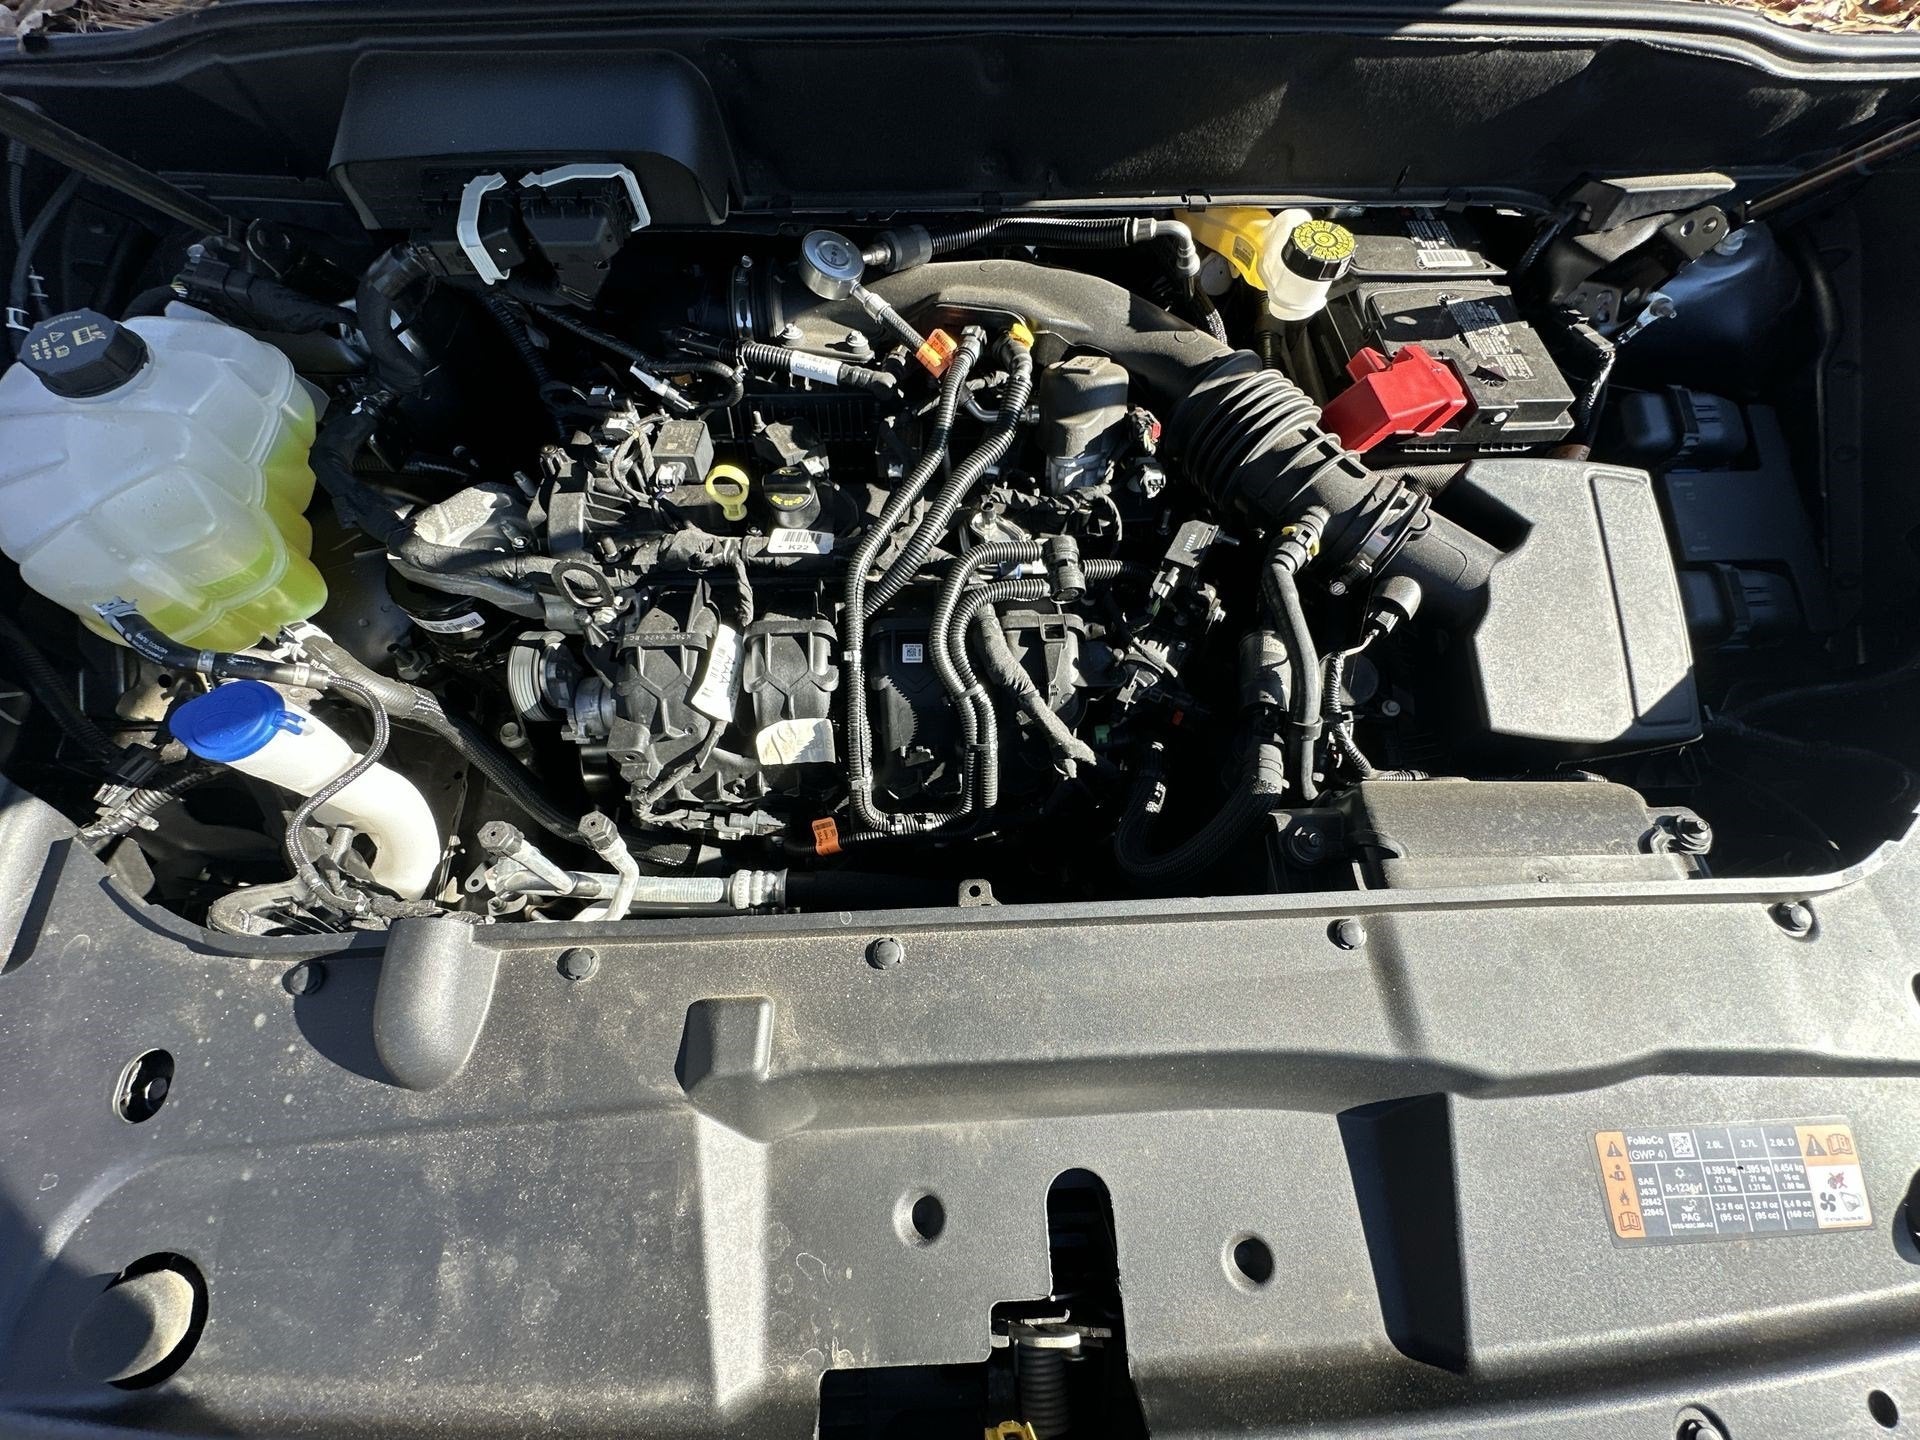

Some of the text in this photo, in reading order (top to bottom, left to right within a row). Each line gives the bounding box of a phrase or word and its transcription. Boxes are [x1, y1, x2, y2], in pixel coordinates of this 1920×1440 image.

[1627, 1136, 1664, 1146] FoMoCo
[1740, 1139, 1758, 1148] 2.7L
[1628, 1149, 1668, 1162] (GWP 4)
[1726, 1166, 1737, 1176] kg
[1760, 1164, 1771, 1176] kg
[1794, 1164, 1805, 1174] kg
[1638, 1178, 1655, 1186] SAE
[1715, 1176, 1723, 1184] 21
[1640, 1188, 1658, 1196] J639
[1665, 1182, 1703, 1195] R-1234yf
[1641, 1198, 1662, 1206] J2842
[1750, 1202, 1762, 1210] 3.2
[1803, 1200, 1812, 1208] oz
[1714, 1203, 1727, 1211] 3.2
[1681, 1213, 1701, 1222] PAG
[1720, 1213, 1746, 1223] (95 cc)
[1755, 1212, 1780, 1222] (95 cc)
[1803, 1210, 1815, 1219] cc)
